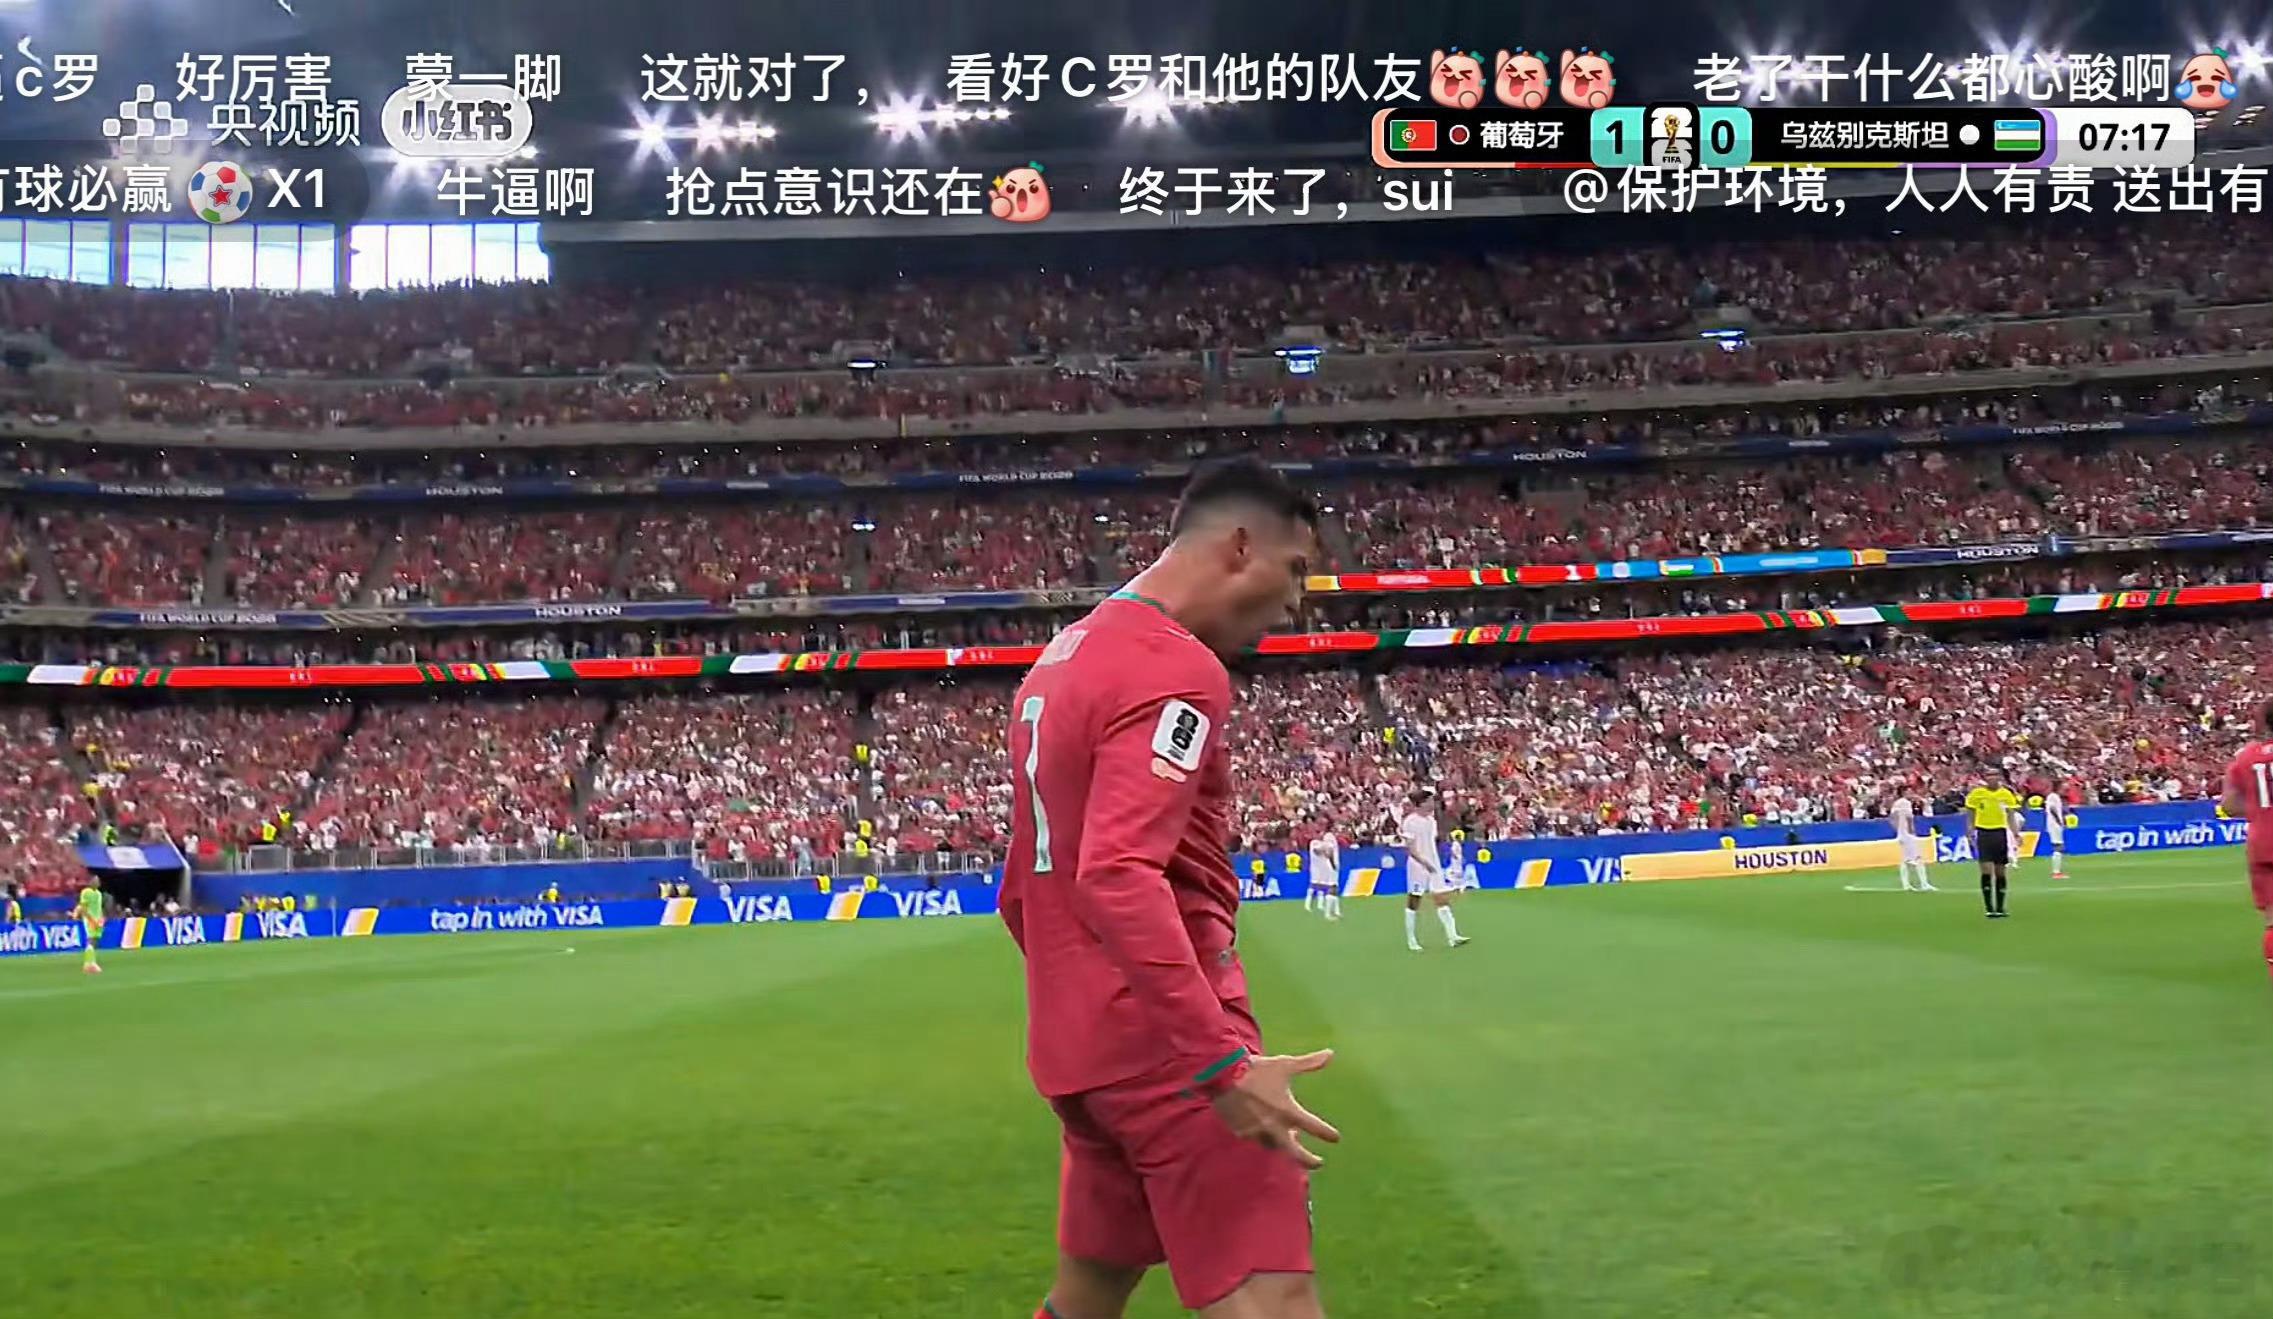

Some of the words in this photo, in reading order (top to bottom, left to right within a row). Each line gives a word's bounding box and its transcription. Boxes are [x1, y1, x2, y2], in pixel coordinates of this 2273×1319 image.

[425, 486, 504, 496] HOUSTON
[1956, 543, 2039, 560] HOUSTON
[534, 605, 623, 618] HOUSTON
[2095, 828, 2134, 852] tap
[2138, 825, 2158, 846] in
[2165, 823, 2214, 846] with
[1734, 850, 1827, 869] HOUSTON
[725, 896, 793, 922] VISA
[895, 889, 963, 915] VISA
[162, 916, 206, 945] VISA
[257, 912, 309, 938] VISA
[431, 908, 467, 932] tap
[471, 906, 492, 929] in
[498, 905, 548, 929] with
[551, 905, 604, 926] VISA
[40, 924, 81, 949] VISA
